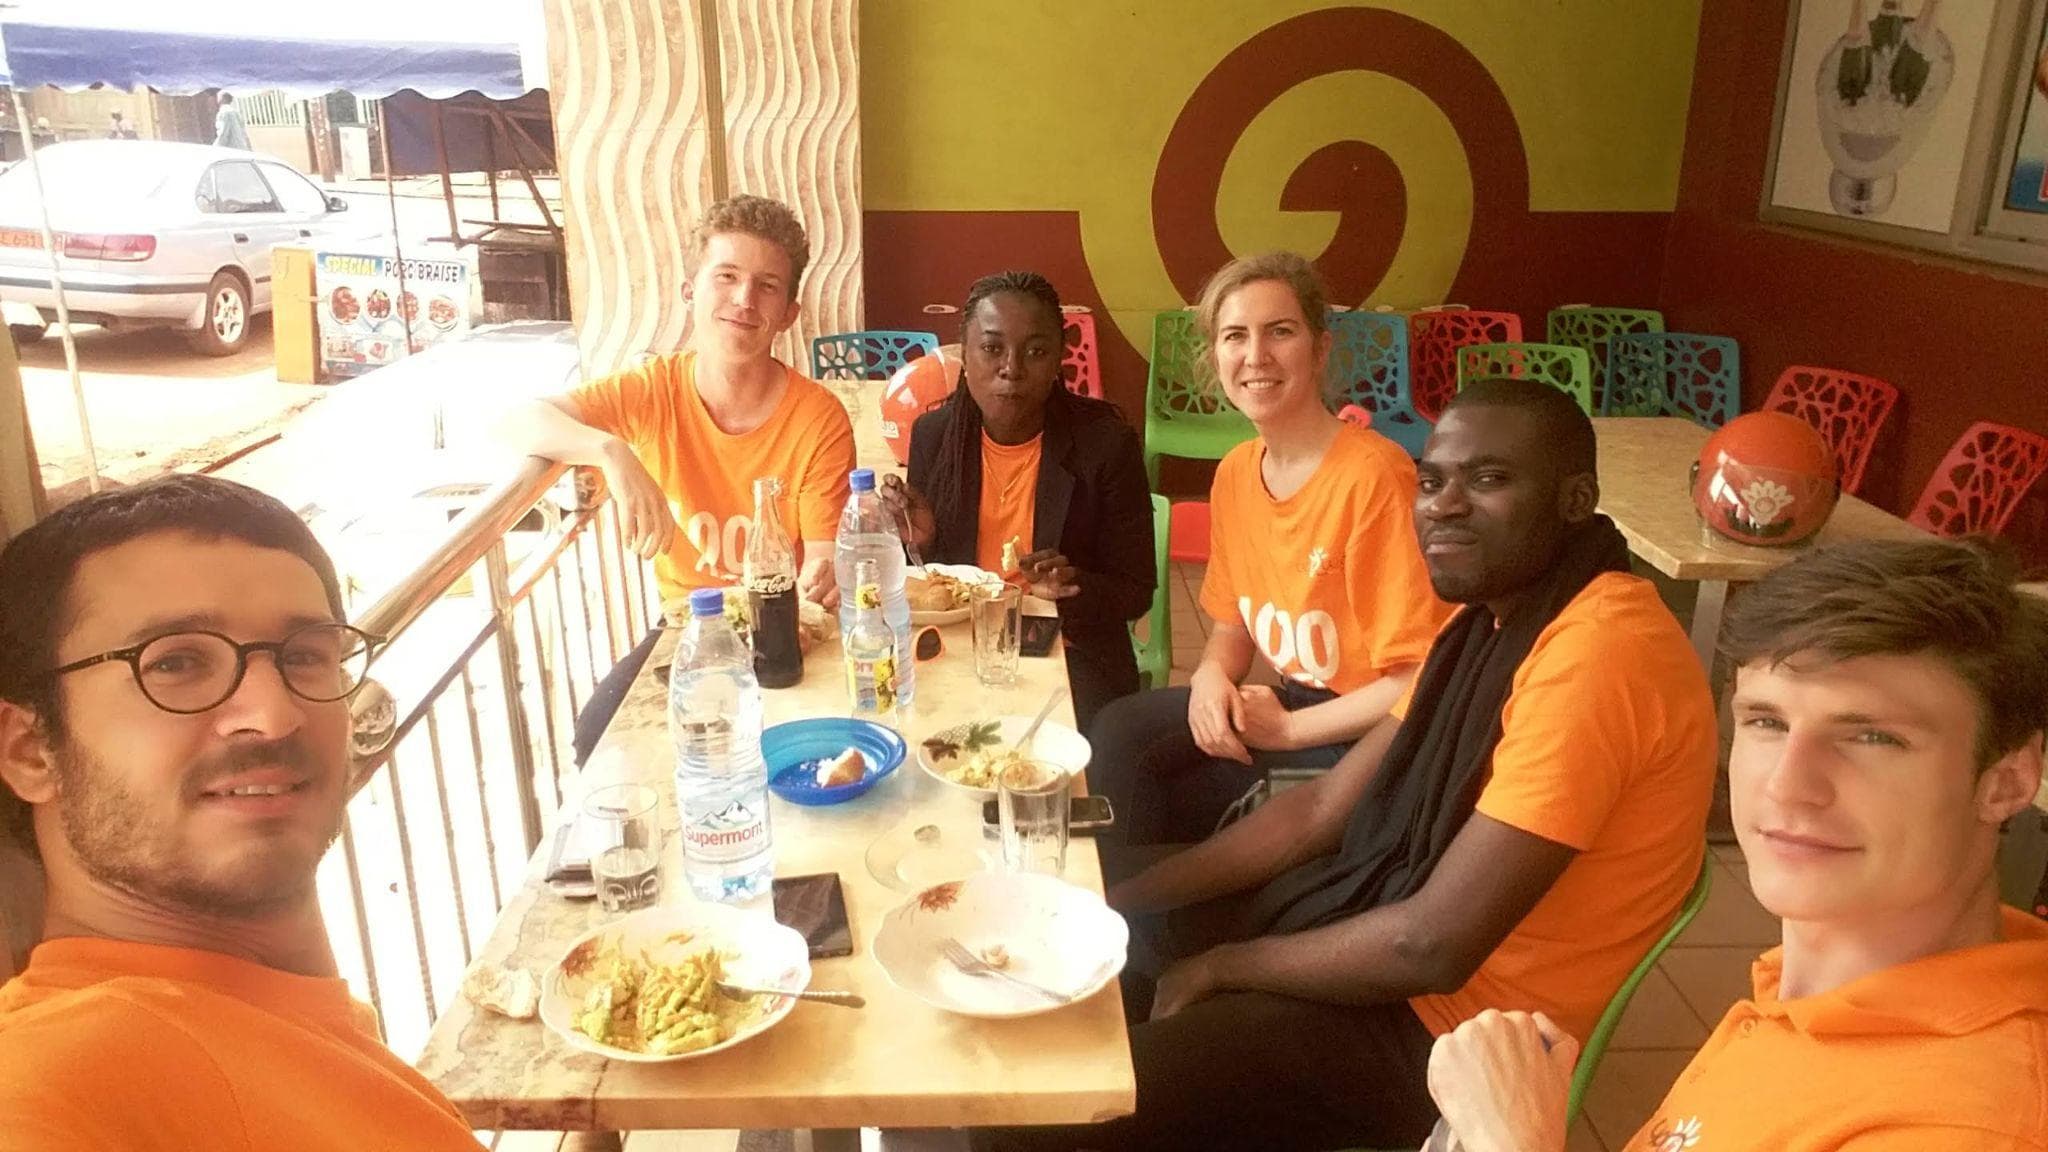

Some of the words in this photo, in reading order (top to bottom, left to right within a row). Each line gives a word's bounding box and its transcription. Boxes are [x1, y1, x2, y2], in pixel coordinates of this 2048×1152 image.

[324, 255, 377, 275] SPECIAL
[417, 262, 459, 283] BRAISE
[671, 500, 753, 576] 00
[685, 820, 764, 847] Supermont
